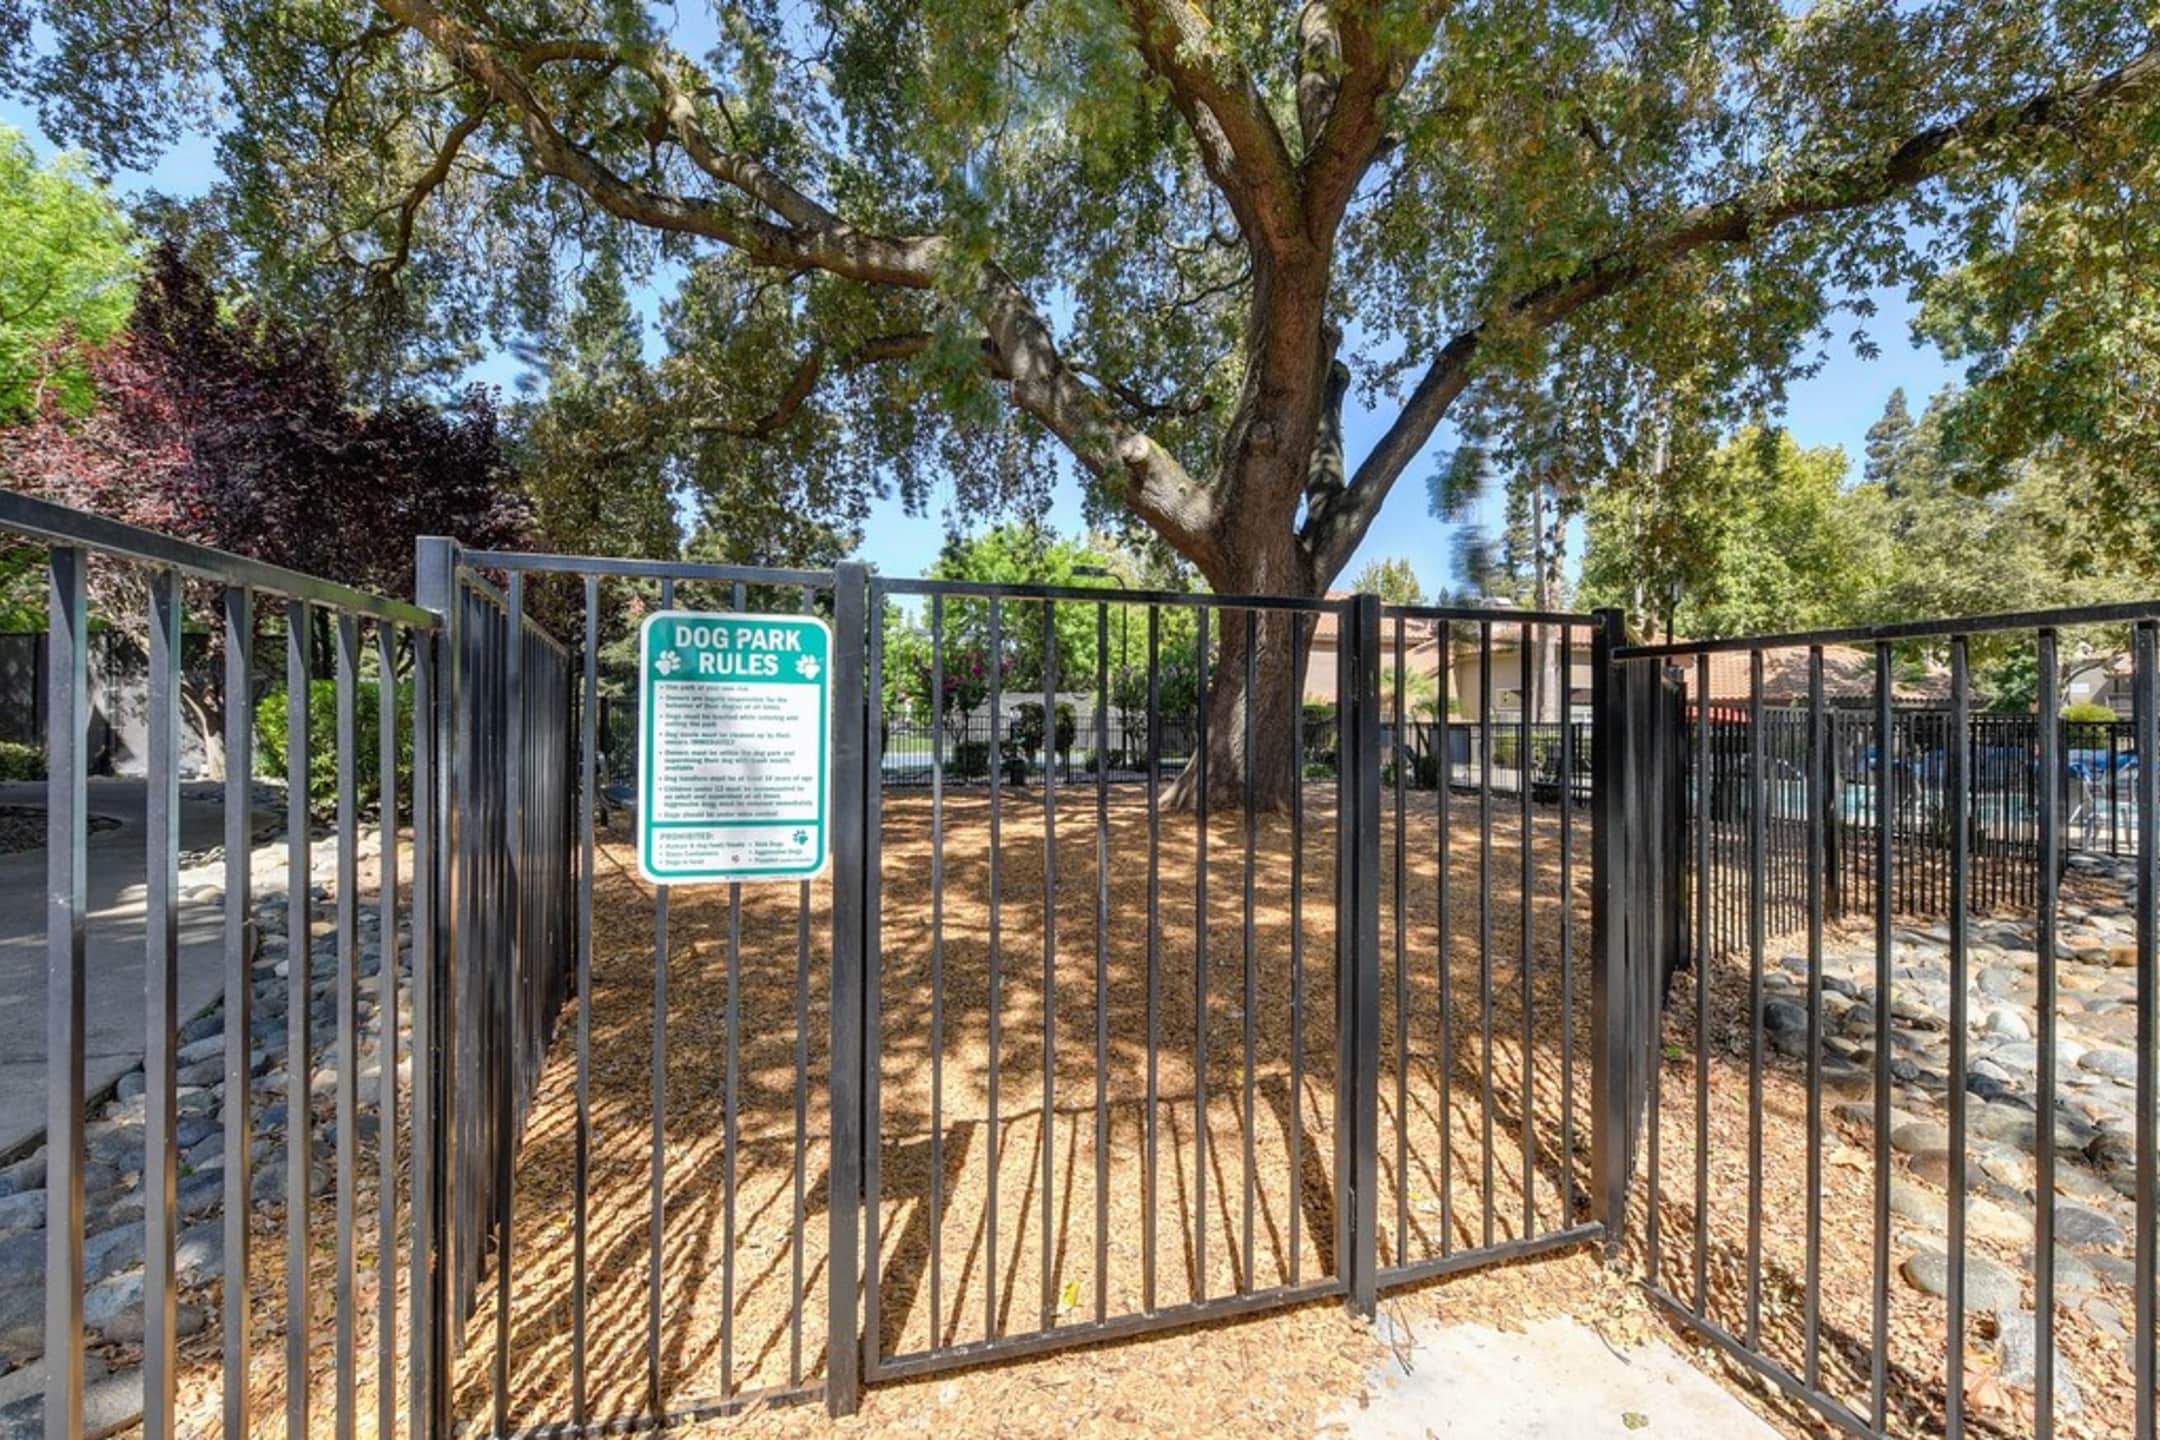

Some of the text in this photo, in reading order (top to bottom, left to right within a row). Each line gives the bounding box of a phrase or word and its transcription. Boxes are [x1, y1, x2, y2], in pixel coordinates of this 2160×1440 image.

[675, 626, 802, 651] DOG PARK
[699, 652, 779, 676] RULES
